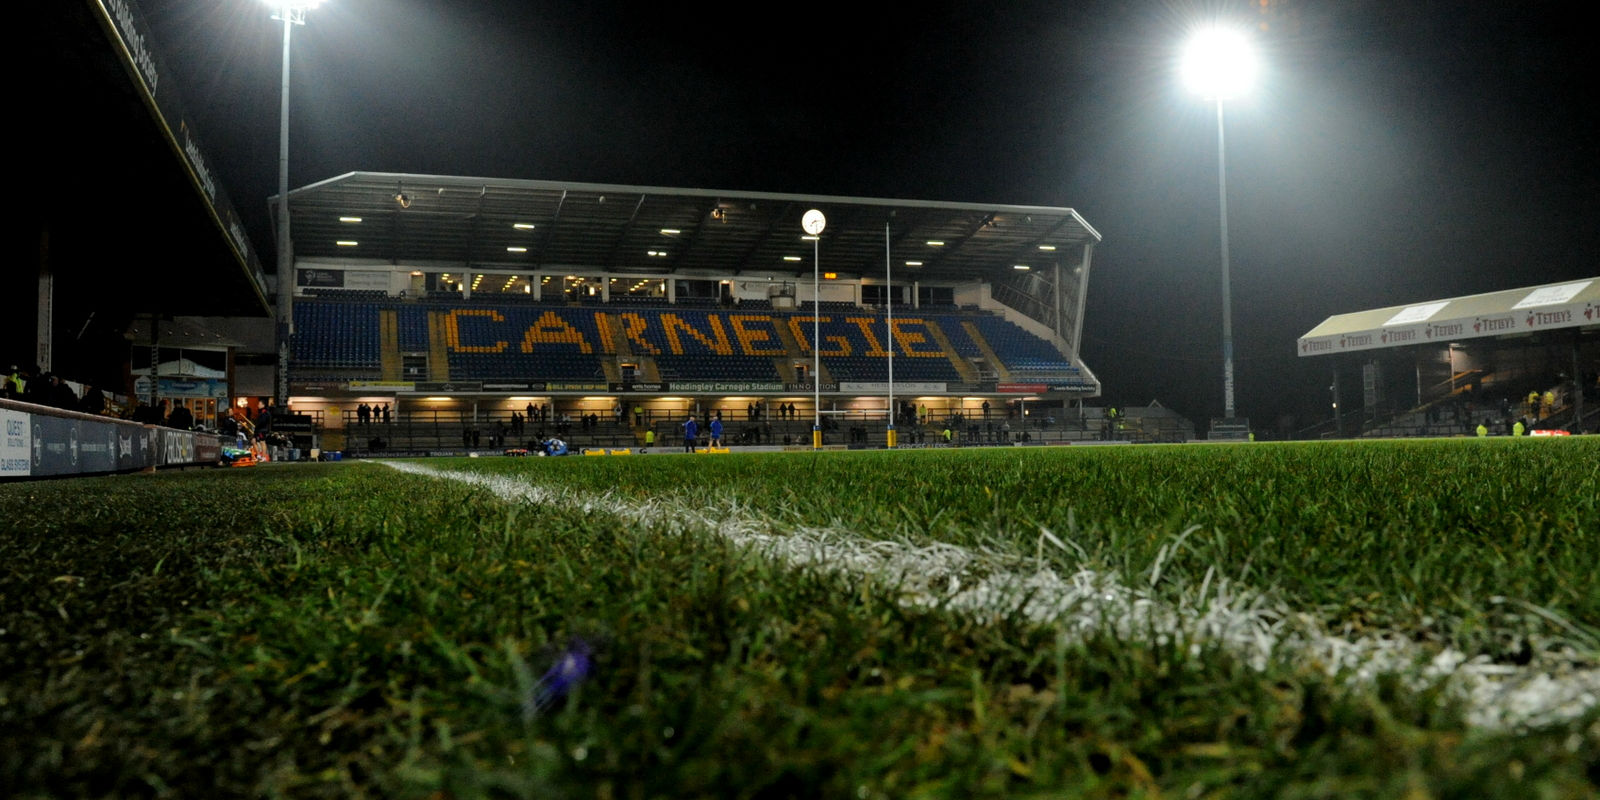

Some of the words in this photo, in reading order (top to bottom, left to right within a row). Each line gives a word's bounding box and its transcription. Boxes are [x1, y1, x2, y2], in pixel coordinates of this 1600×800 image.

[444, 308, 946, 358] CARNEGIE
[669, 383, 714, 391] Headingley
[715, 383, 750, 391] Carnegie
